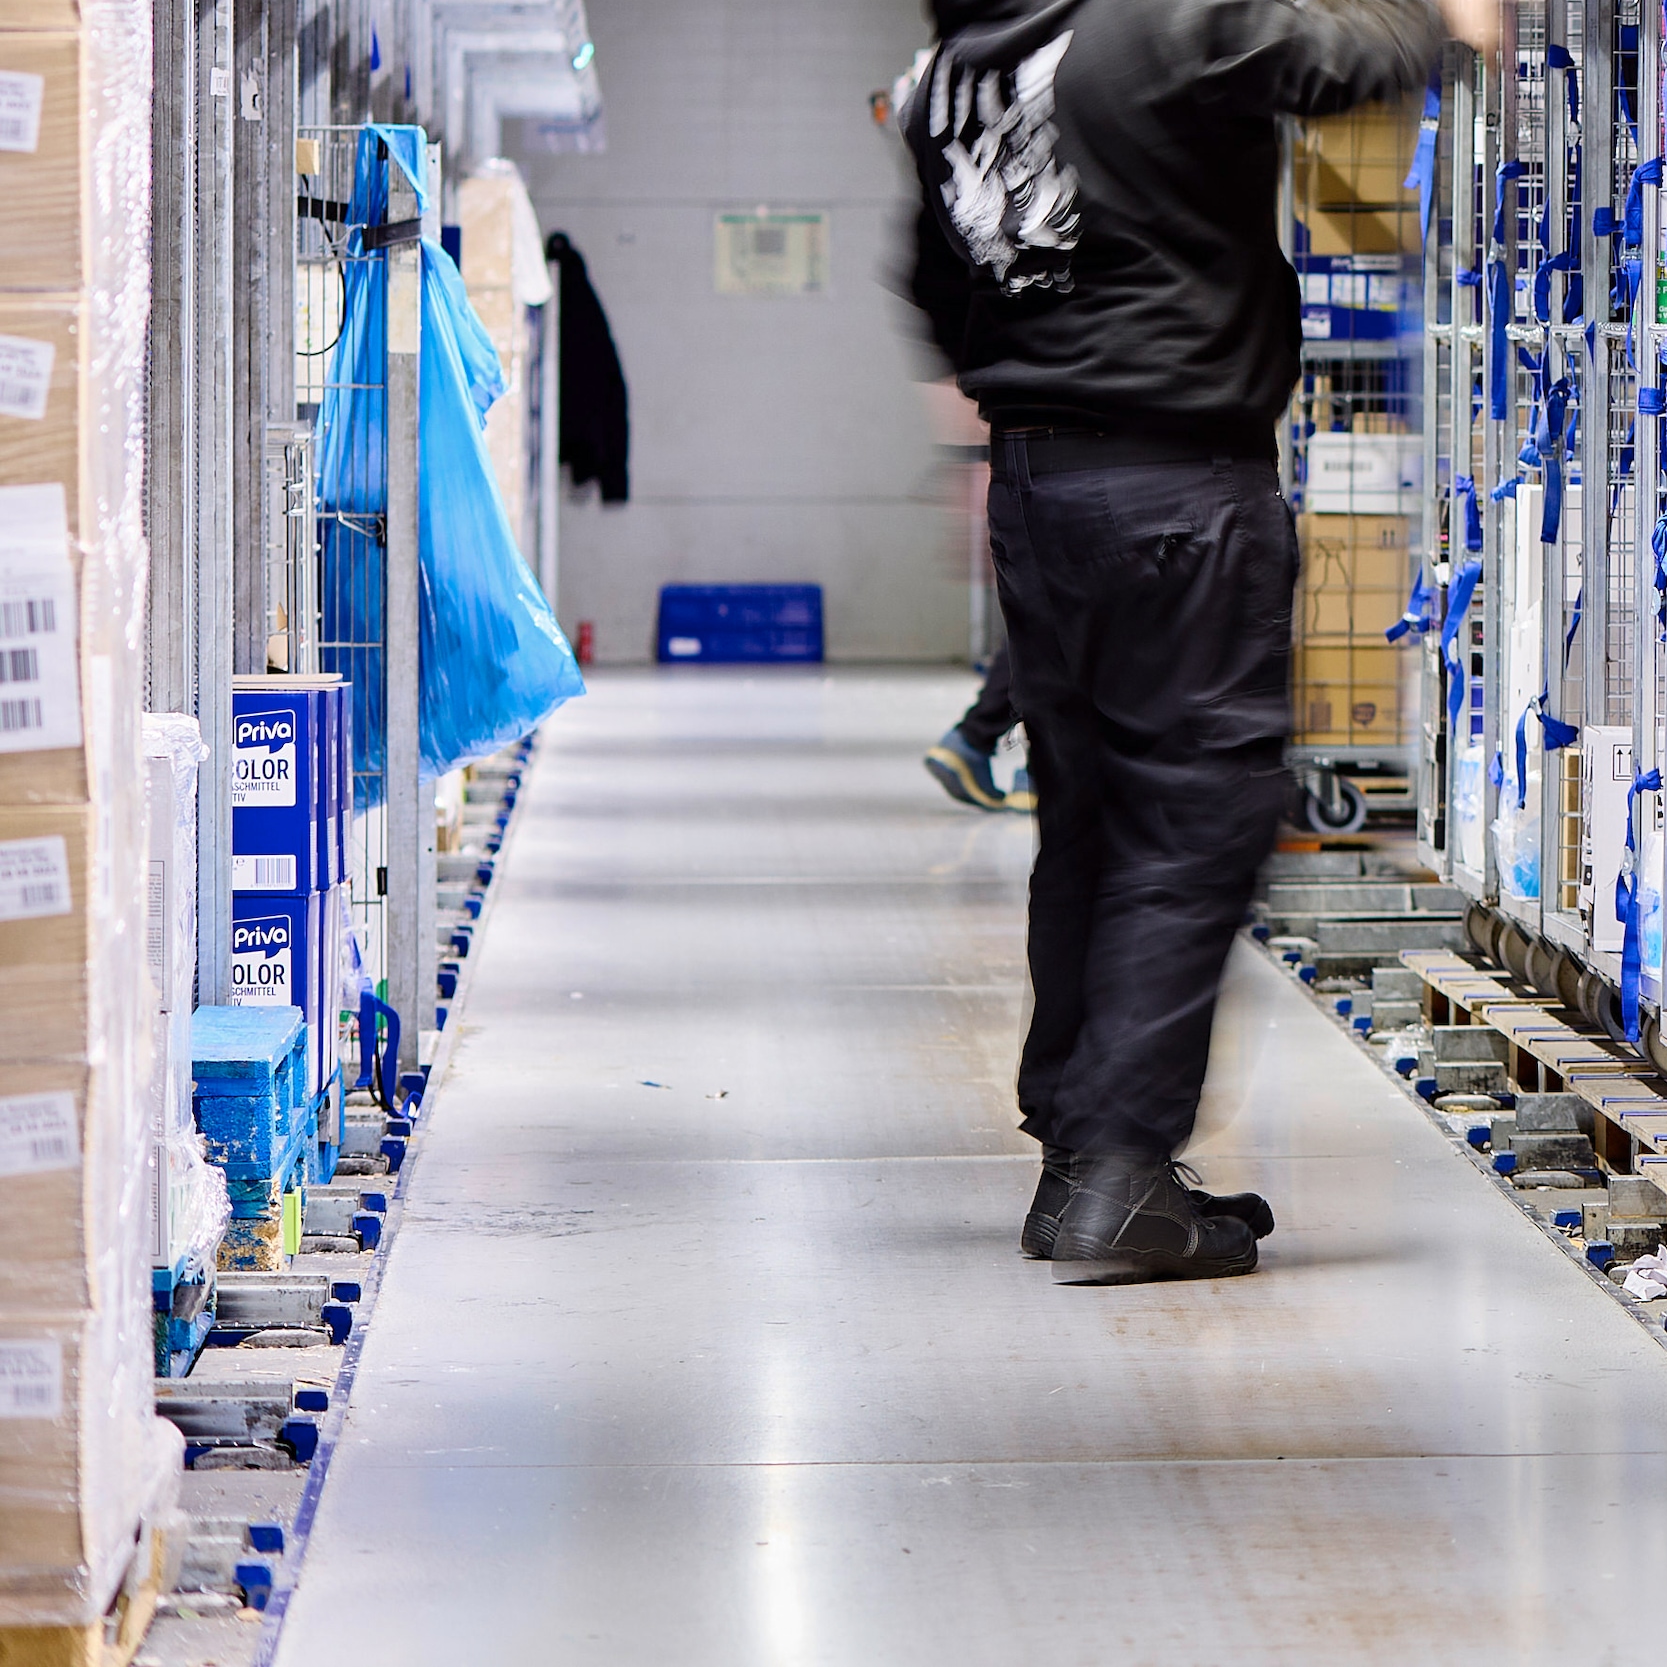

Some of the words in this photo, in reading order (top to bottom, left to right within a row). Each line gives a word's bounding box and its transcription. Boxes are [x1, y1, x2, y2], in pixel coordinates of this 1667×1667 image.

[238, 720, 293, 744] Priva
[231, 759, 290, 780] OLOR
[231, 793, 247, 802] TIV
[234, 925, 288, 948] Priva
[232, 963, 286, 985] OLOR
[231, 986, 277, 997] SCHMITTEL
